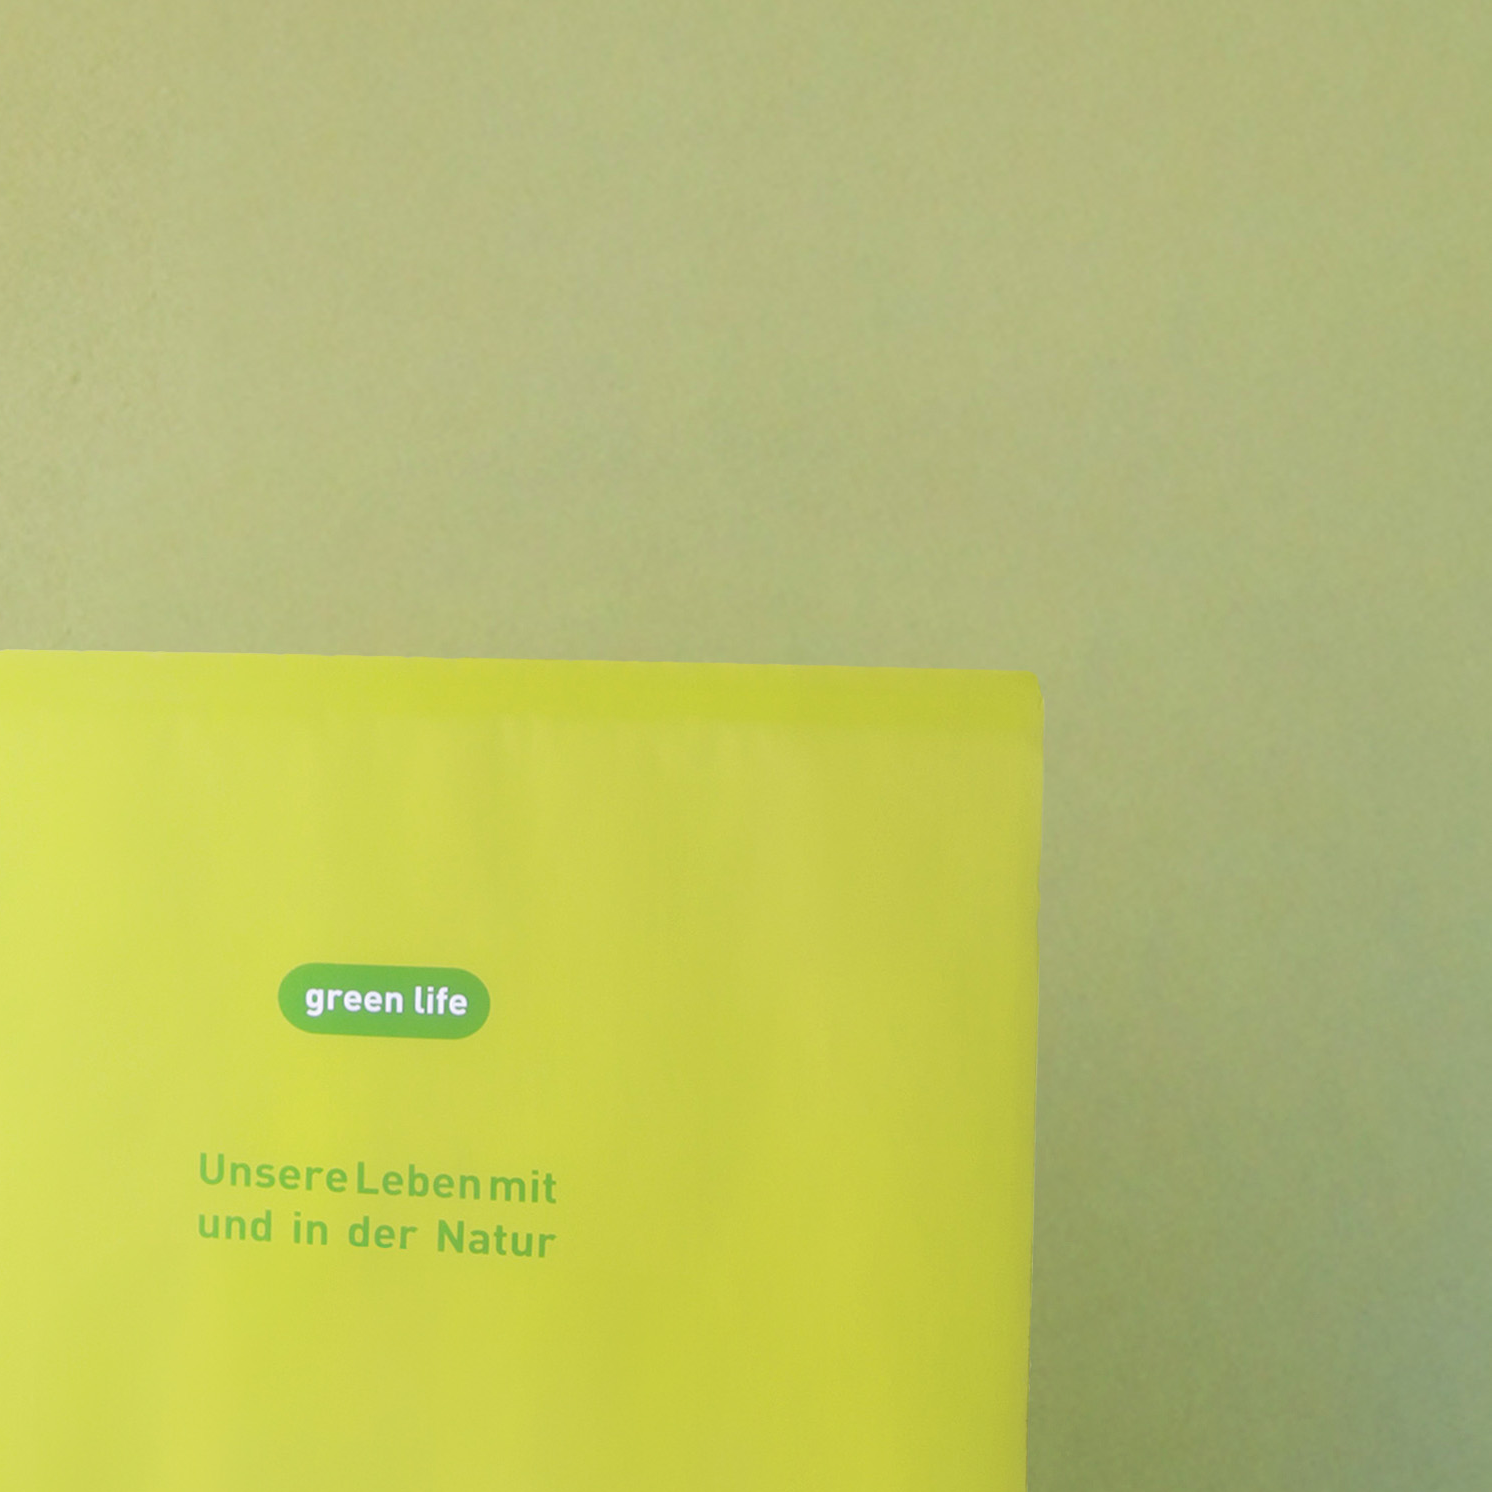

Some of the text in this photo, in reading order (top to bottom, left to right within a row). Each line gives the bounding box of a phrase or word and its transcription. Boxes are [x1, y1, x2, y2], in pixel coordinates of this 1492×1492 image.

[305, 986, 468, 1017] green life
[199, 1152, 557, 1204] Unsere Leben mit
[198, 1209, 557, 1259] und in der Natur
